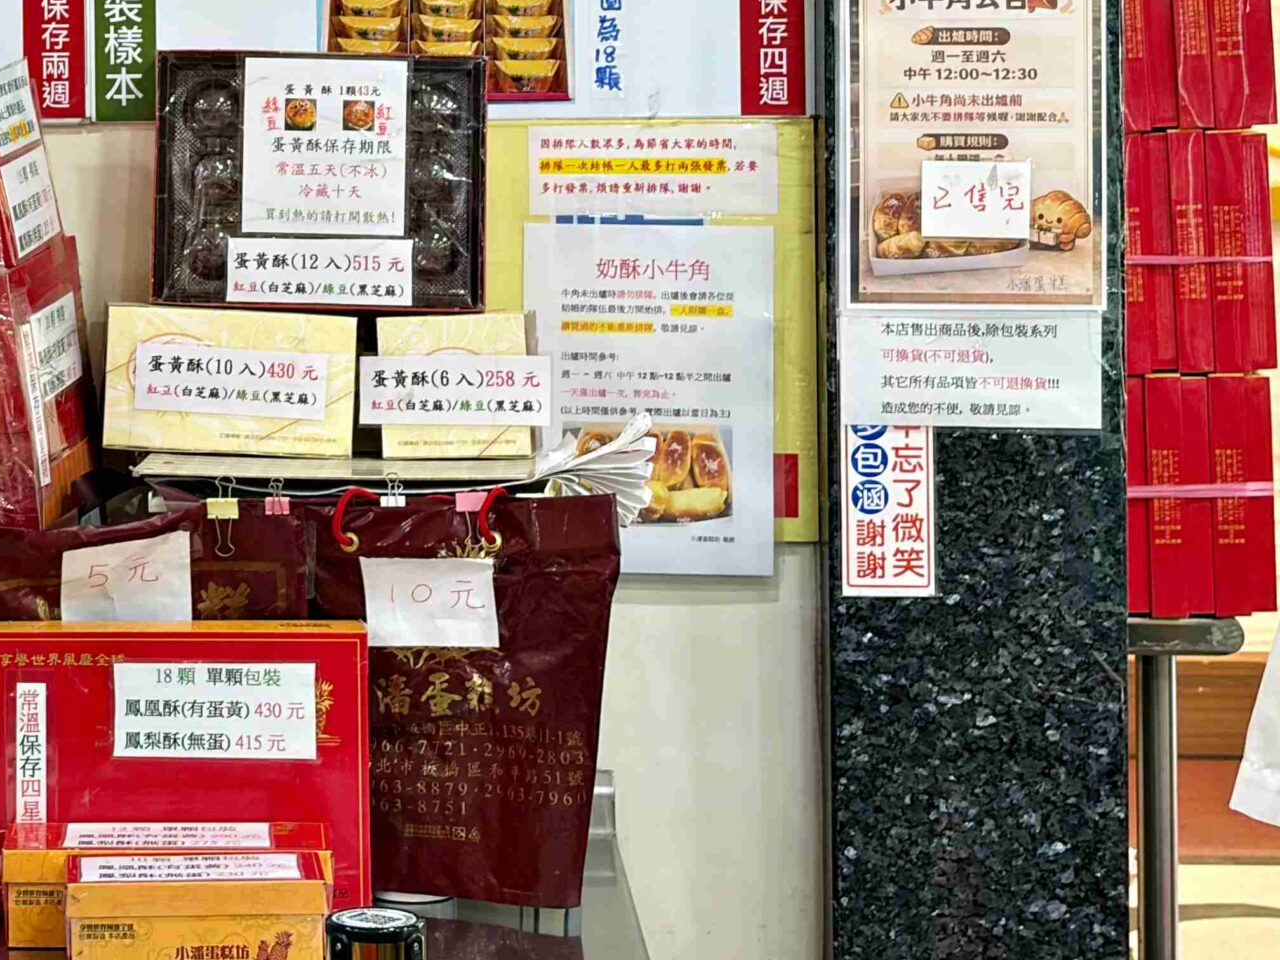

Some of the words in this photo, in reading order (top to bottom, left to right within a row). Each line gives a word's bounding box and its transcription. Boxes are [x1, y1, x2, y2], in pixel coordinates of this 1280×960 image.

[930, 50, 1007, 64] 週一至週六
[903, 67, 931, 81] 中午
[272, 137, 392, 155] 蛋黃酥保存期限
[276, 162, 387, 178] 常溫五天(不冰)
[299, 184, 362, 199] 冷藏十天
[596, 258, 710, 282] 奶酥小牛角
[206, 668, 282, 687] 單顆包裝
[124, 699, 250, 720] 鳳凰酥(有蛋黃)
[124, 732, 232, 752] 鳳梨酥(無蛋)
